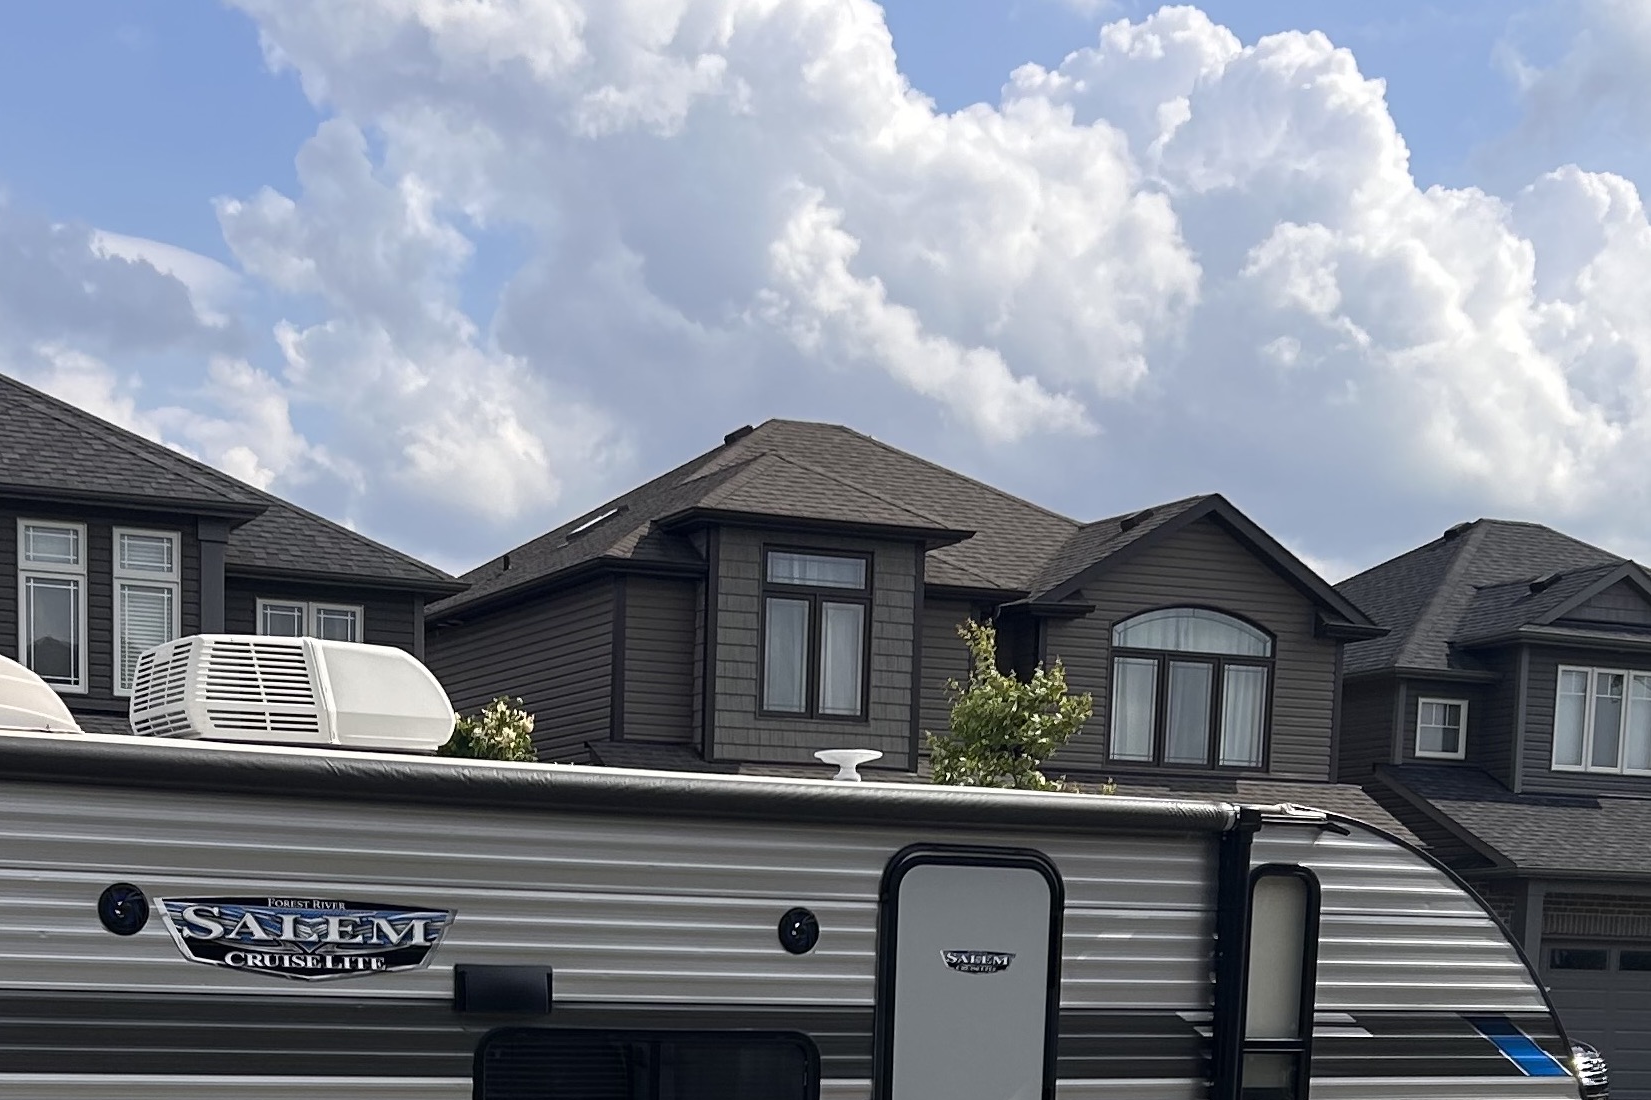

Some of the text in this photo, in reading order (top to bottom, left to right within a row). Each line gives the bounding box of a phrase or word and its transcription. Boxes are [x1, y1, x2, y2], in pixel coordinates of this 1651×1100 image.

[268, 898, 346, 910] FOREST RIVER
[181, 906, 433, 946] SALEM
[946, 952, 1008, 965] SALEM
